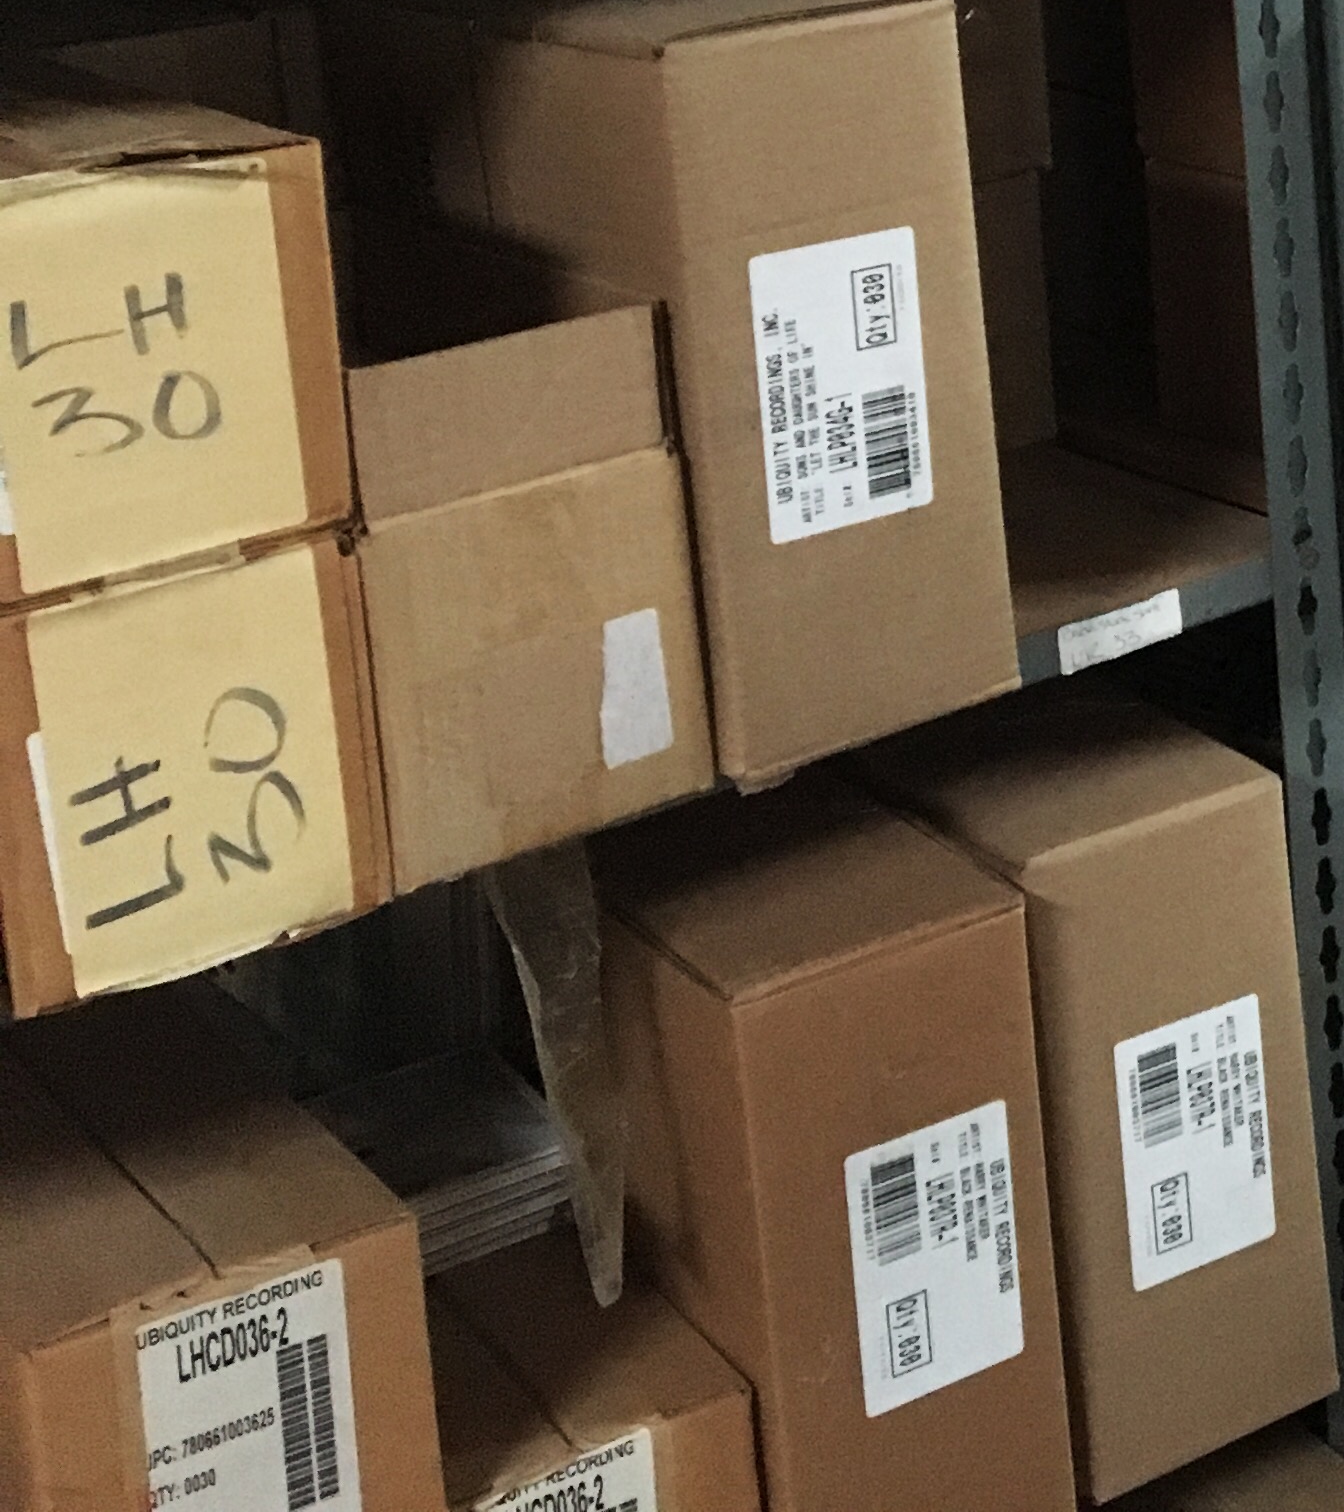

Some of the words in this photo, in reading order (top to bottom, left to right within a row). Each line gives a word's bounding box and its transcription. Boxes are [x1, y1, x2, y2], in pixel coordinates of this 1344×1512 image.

[862, 273, 890, 346] Qty:030
[33, 369, 222, 458] 30
[773, 441, 793, 505] UBIQUITY
[205, 689, 306, 883] 30
[1244, 1050, 1261, 1104] UBIQUITY
[1249, 1109, 1266, 1179] RECORDINGS
[990, 1158, 1009, 1217] UBIQUITY
[994, 1220, 1014, 1294] RECORDINGS
[135, 1308, 216, 1351] UBIQUITY
[223, 1269, 324, 1320] RECORDING
[893, 1298, 921, 1367] Qty:030
[176, 1307, 290, 1384] LHCD036-2
[181, 1406, 276, 1460] 780661003625
[184, 1467, 217, 1496] 0030
